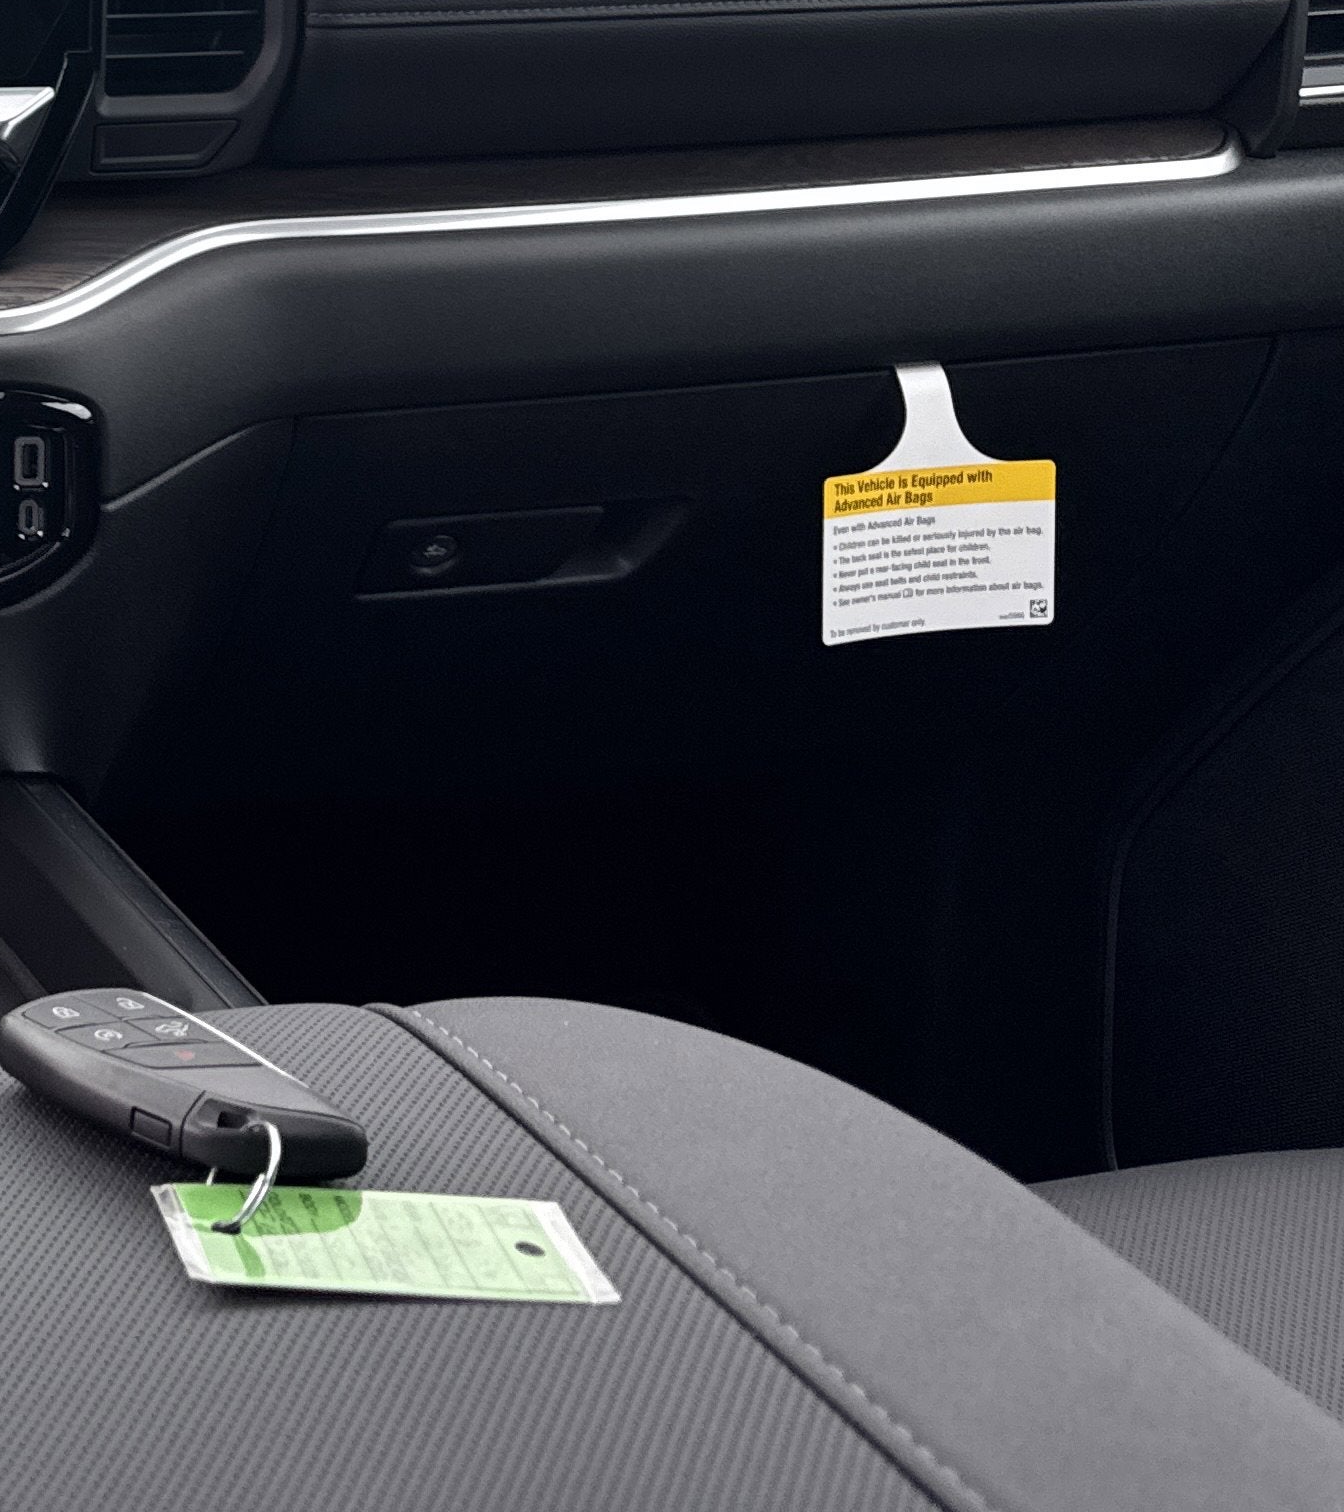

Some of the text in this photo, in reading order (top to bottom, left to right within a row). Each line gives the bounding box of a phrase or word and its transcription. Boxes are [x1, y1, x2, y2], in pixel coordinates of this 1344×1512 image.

[834, 482, 855, 496] This
[857, 476, 895, 494] Vehicle
[912, 472, 963, 489] Equipped
[967, 470, 992, 483] with
[834, 491, 933, 513] Advanced Air Bags
